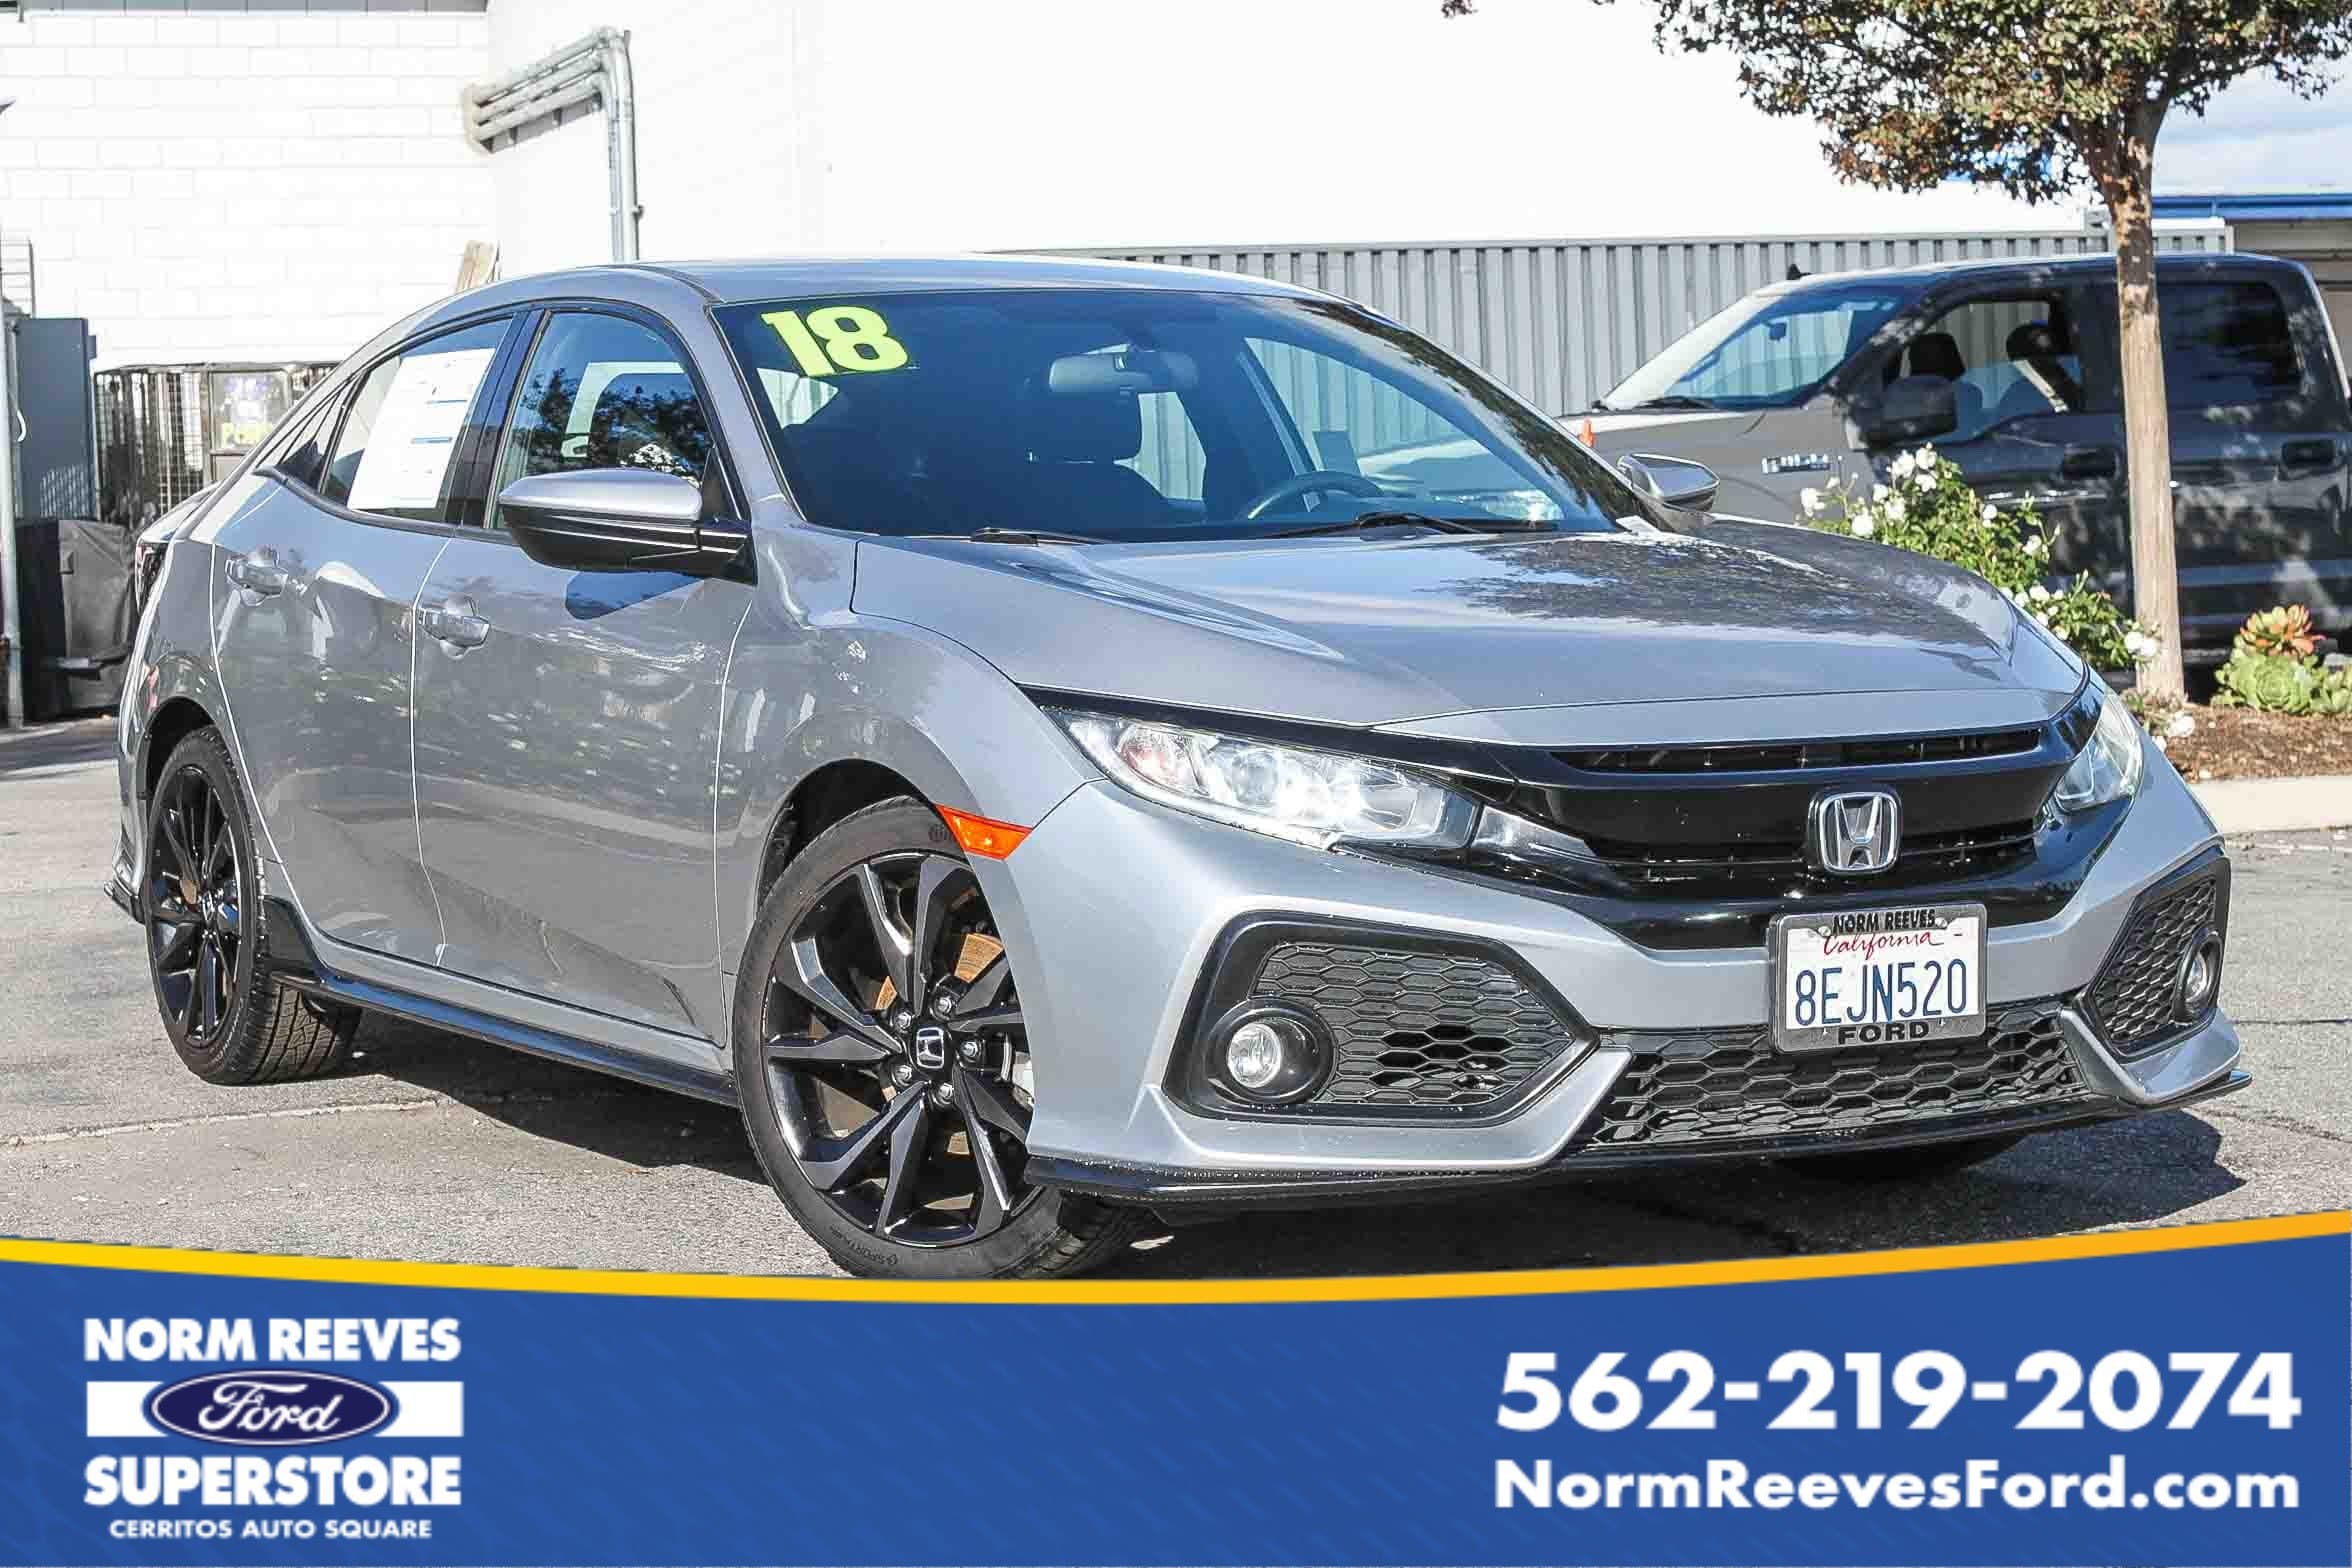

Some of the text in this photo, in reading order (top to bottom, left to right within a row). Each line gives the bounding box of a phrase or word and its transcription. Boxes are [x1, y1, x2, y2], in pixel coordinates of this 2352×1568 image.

[760, 306, 909, 377] 18
[1833, 909, 1935, 934] NORM REEVES
[1823, 931, 1944, 960] California
[1795, 959, 1967, 1026] 8EJN520
[1838, 1021, 1929, 1045] FORD
